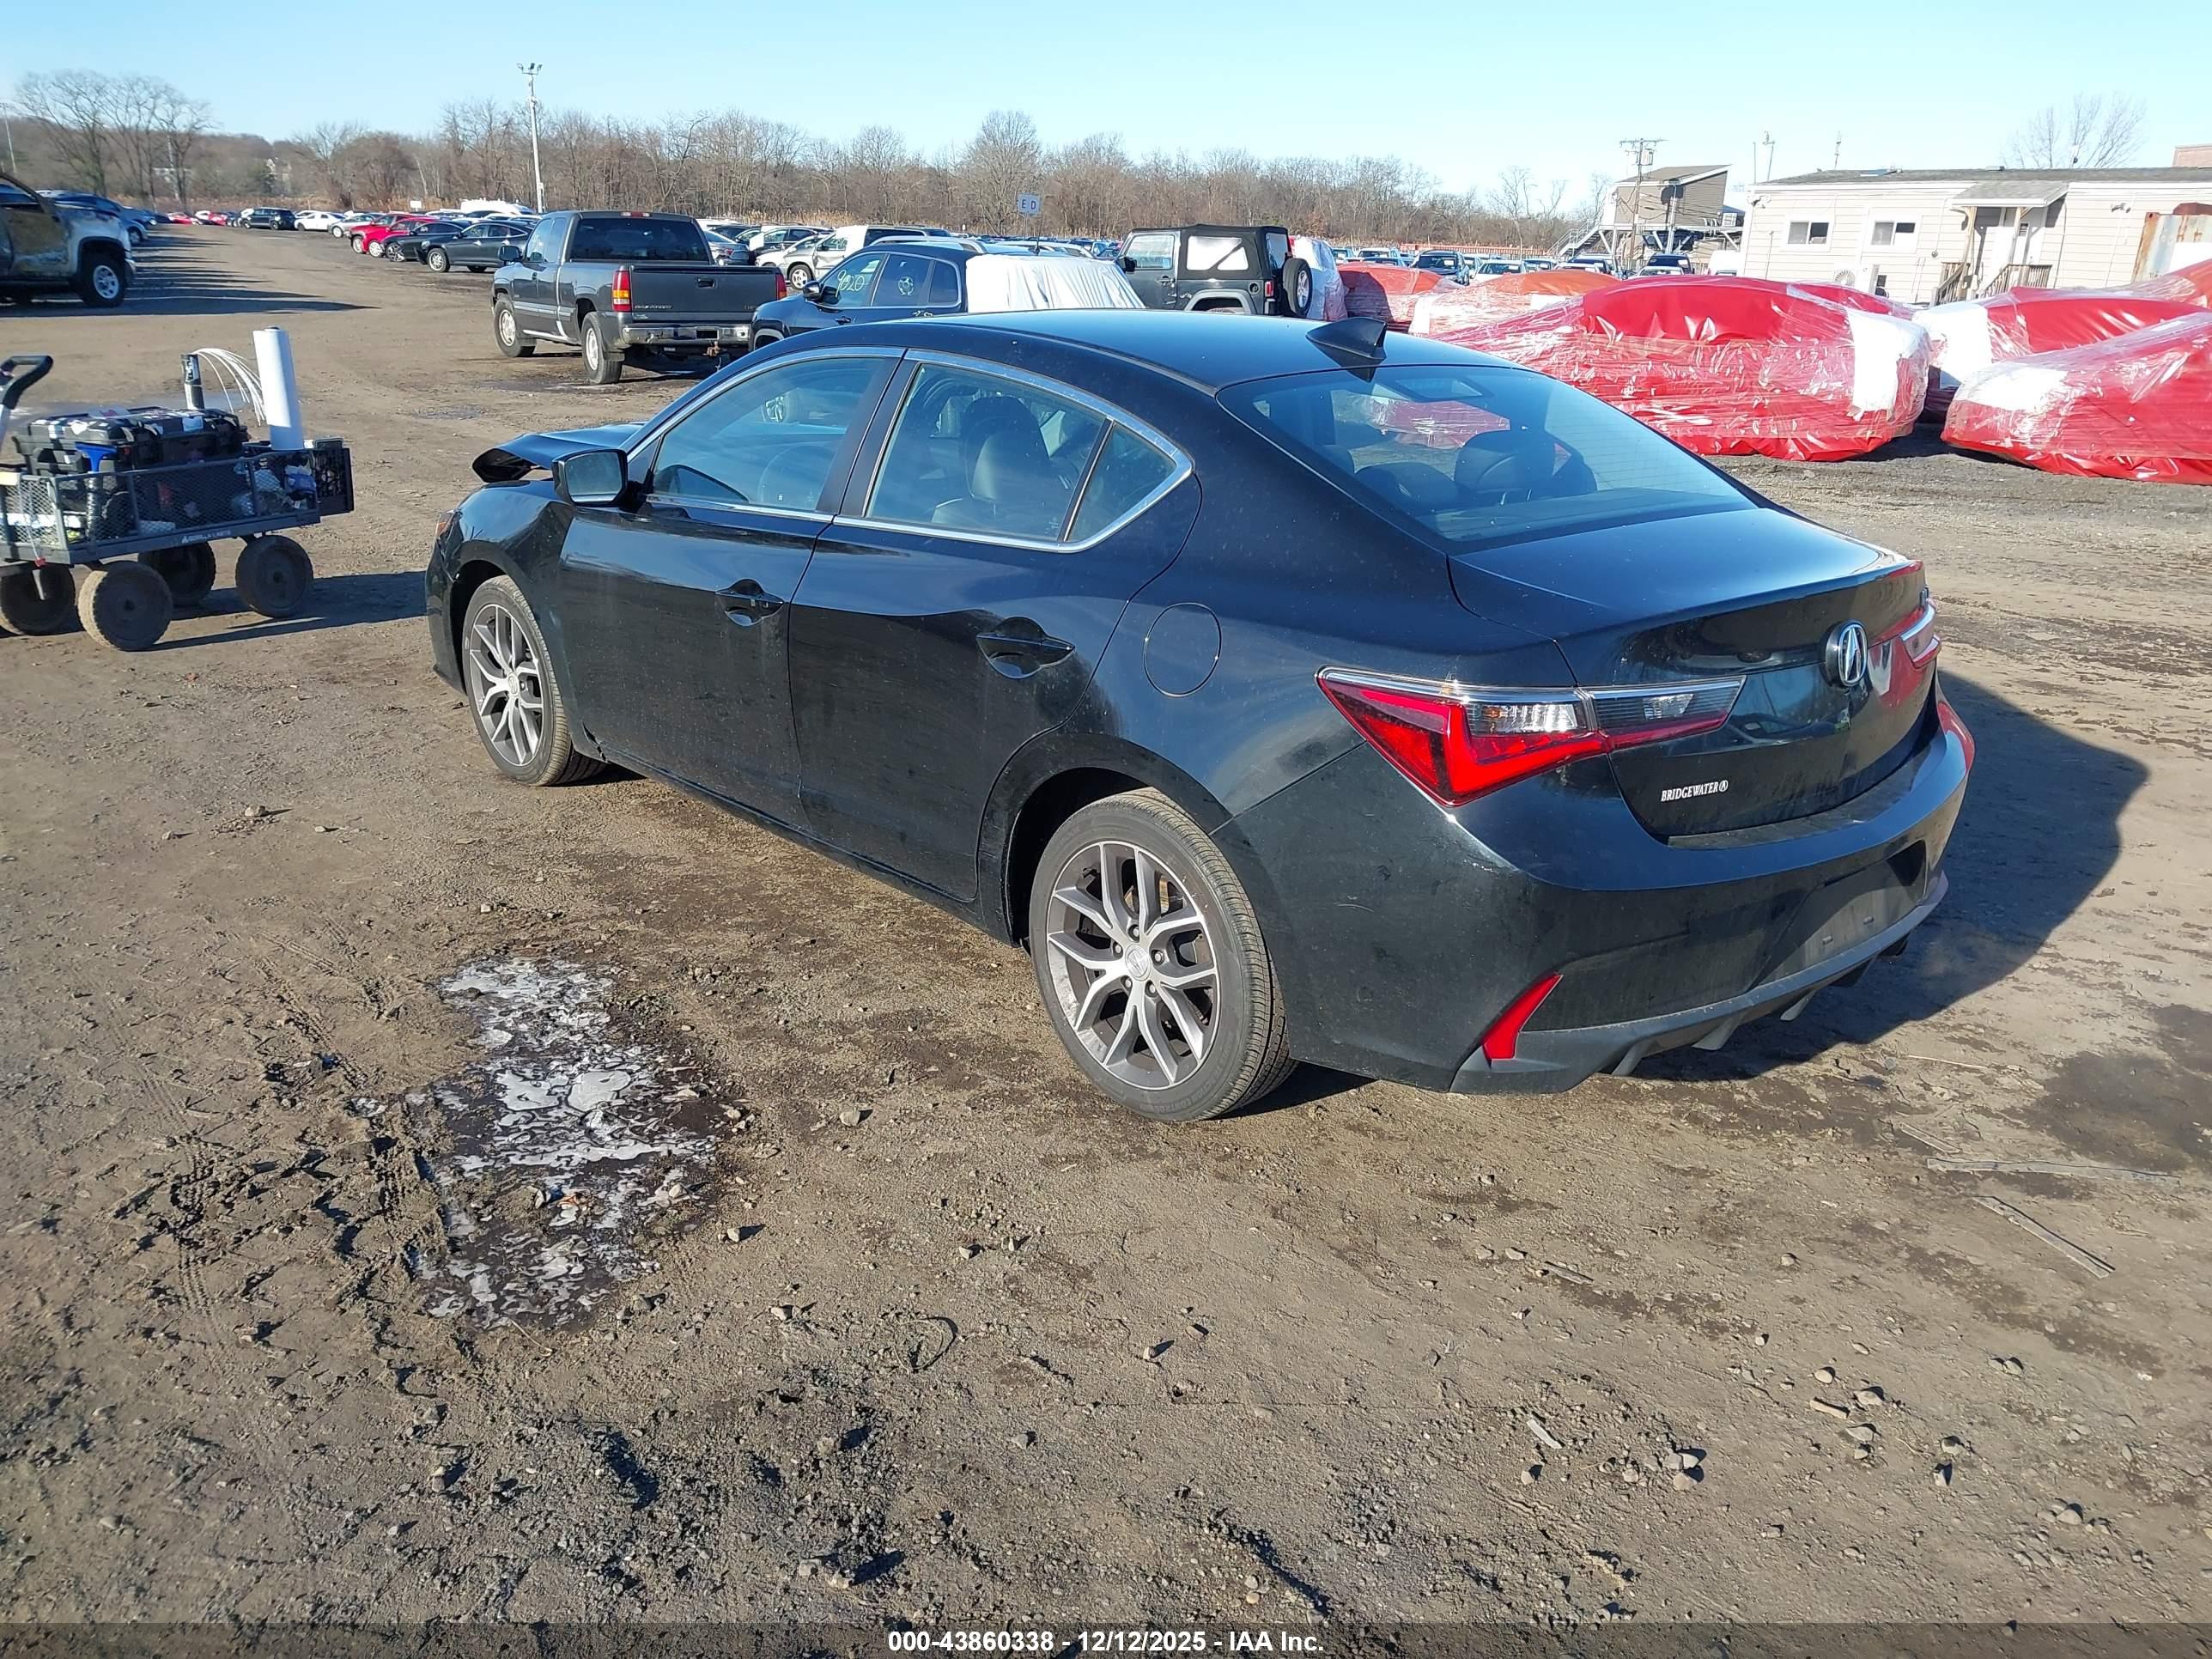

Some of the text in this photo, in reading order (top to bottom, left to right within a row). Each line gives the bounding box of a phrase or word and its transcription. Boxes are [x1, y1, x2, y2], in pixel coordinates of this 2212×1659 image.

[1021, 198, 1036, 210] E D
[1661, 781, 1719, 802] BRIDGEWATER
